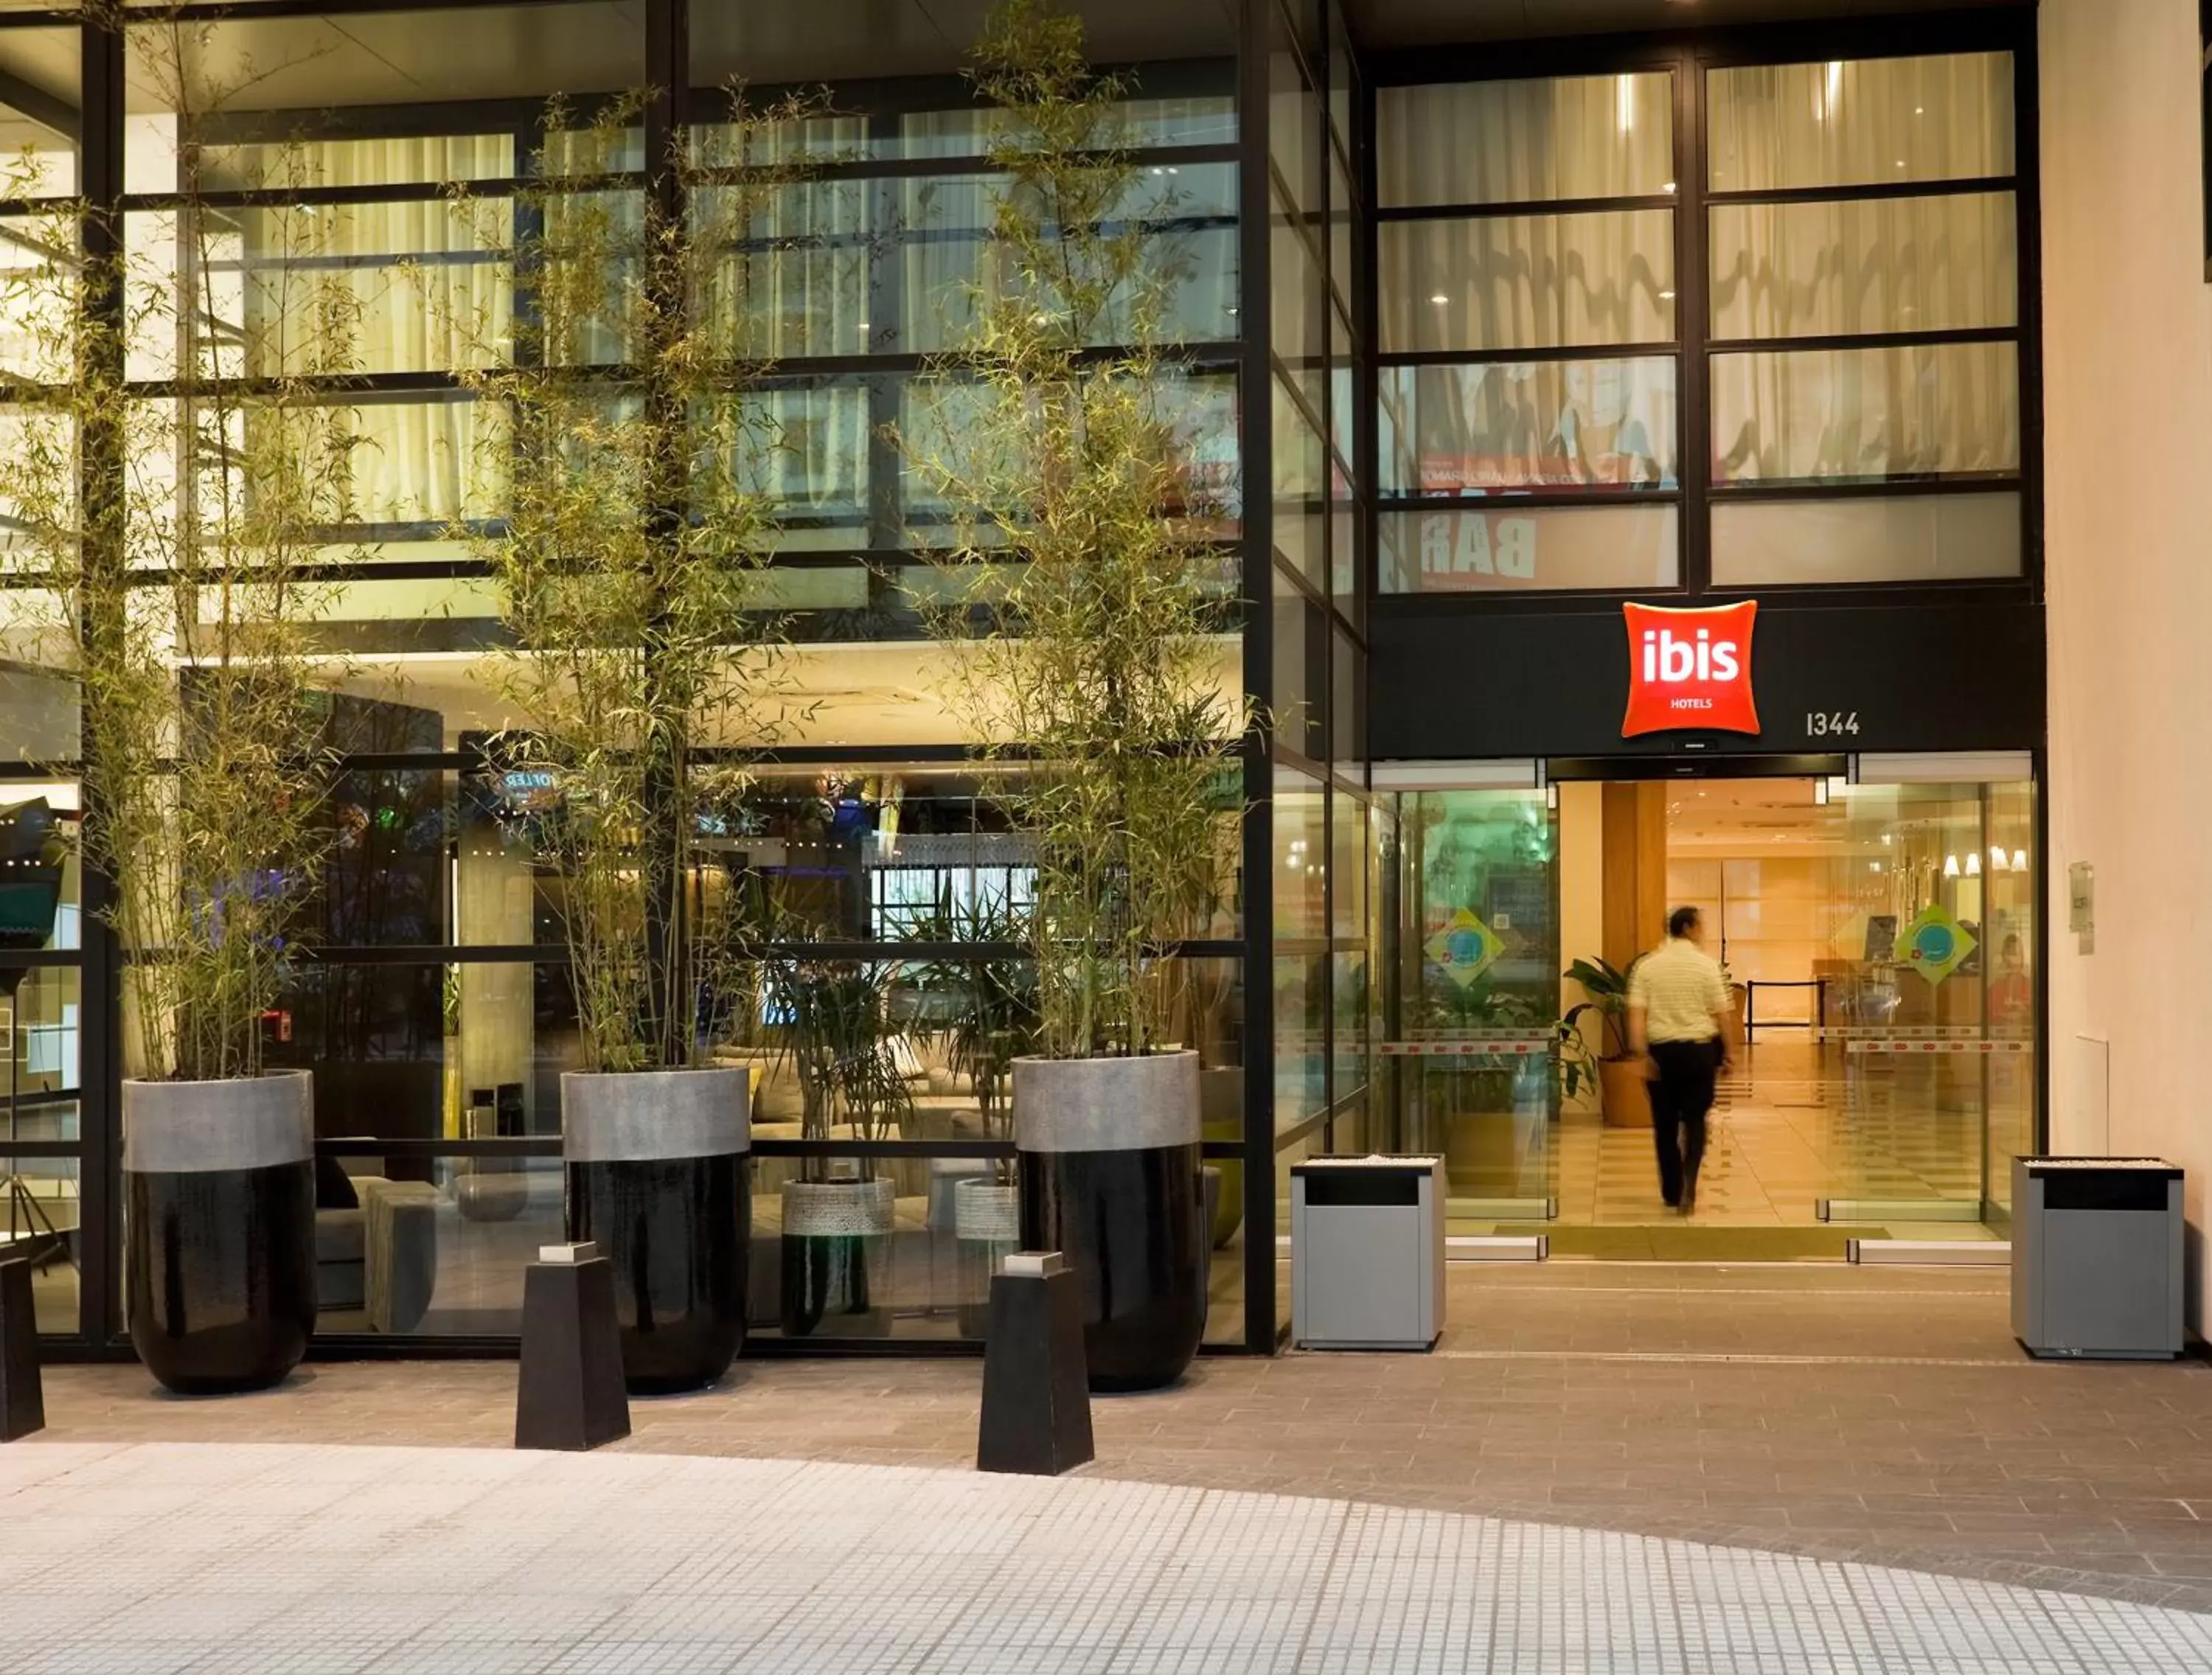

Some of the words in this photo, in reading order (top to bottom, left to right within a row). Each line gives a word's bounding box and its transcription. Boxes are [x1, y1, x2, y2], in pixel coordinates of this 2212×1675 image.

[1643, 628, 1739, 683] ibis
[1670, 697, 1713, 709] HOTELS
[1807, 712, 1860, 736] 1344
